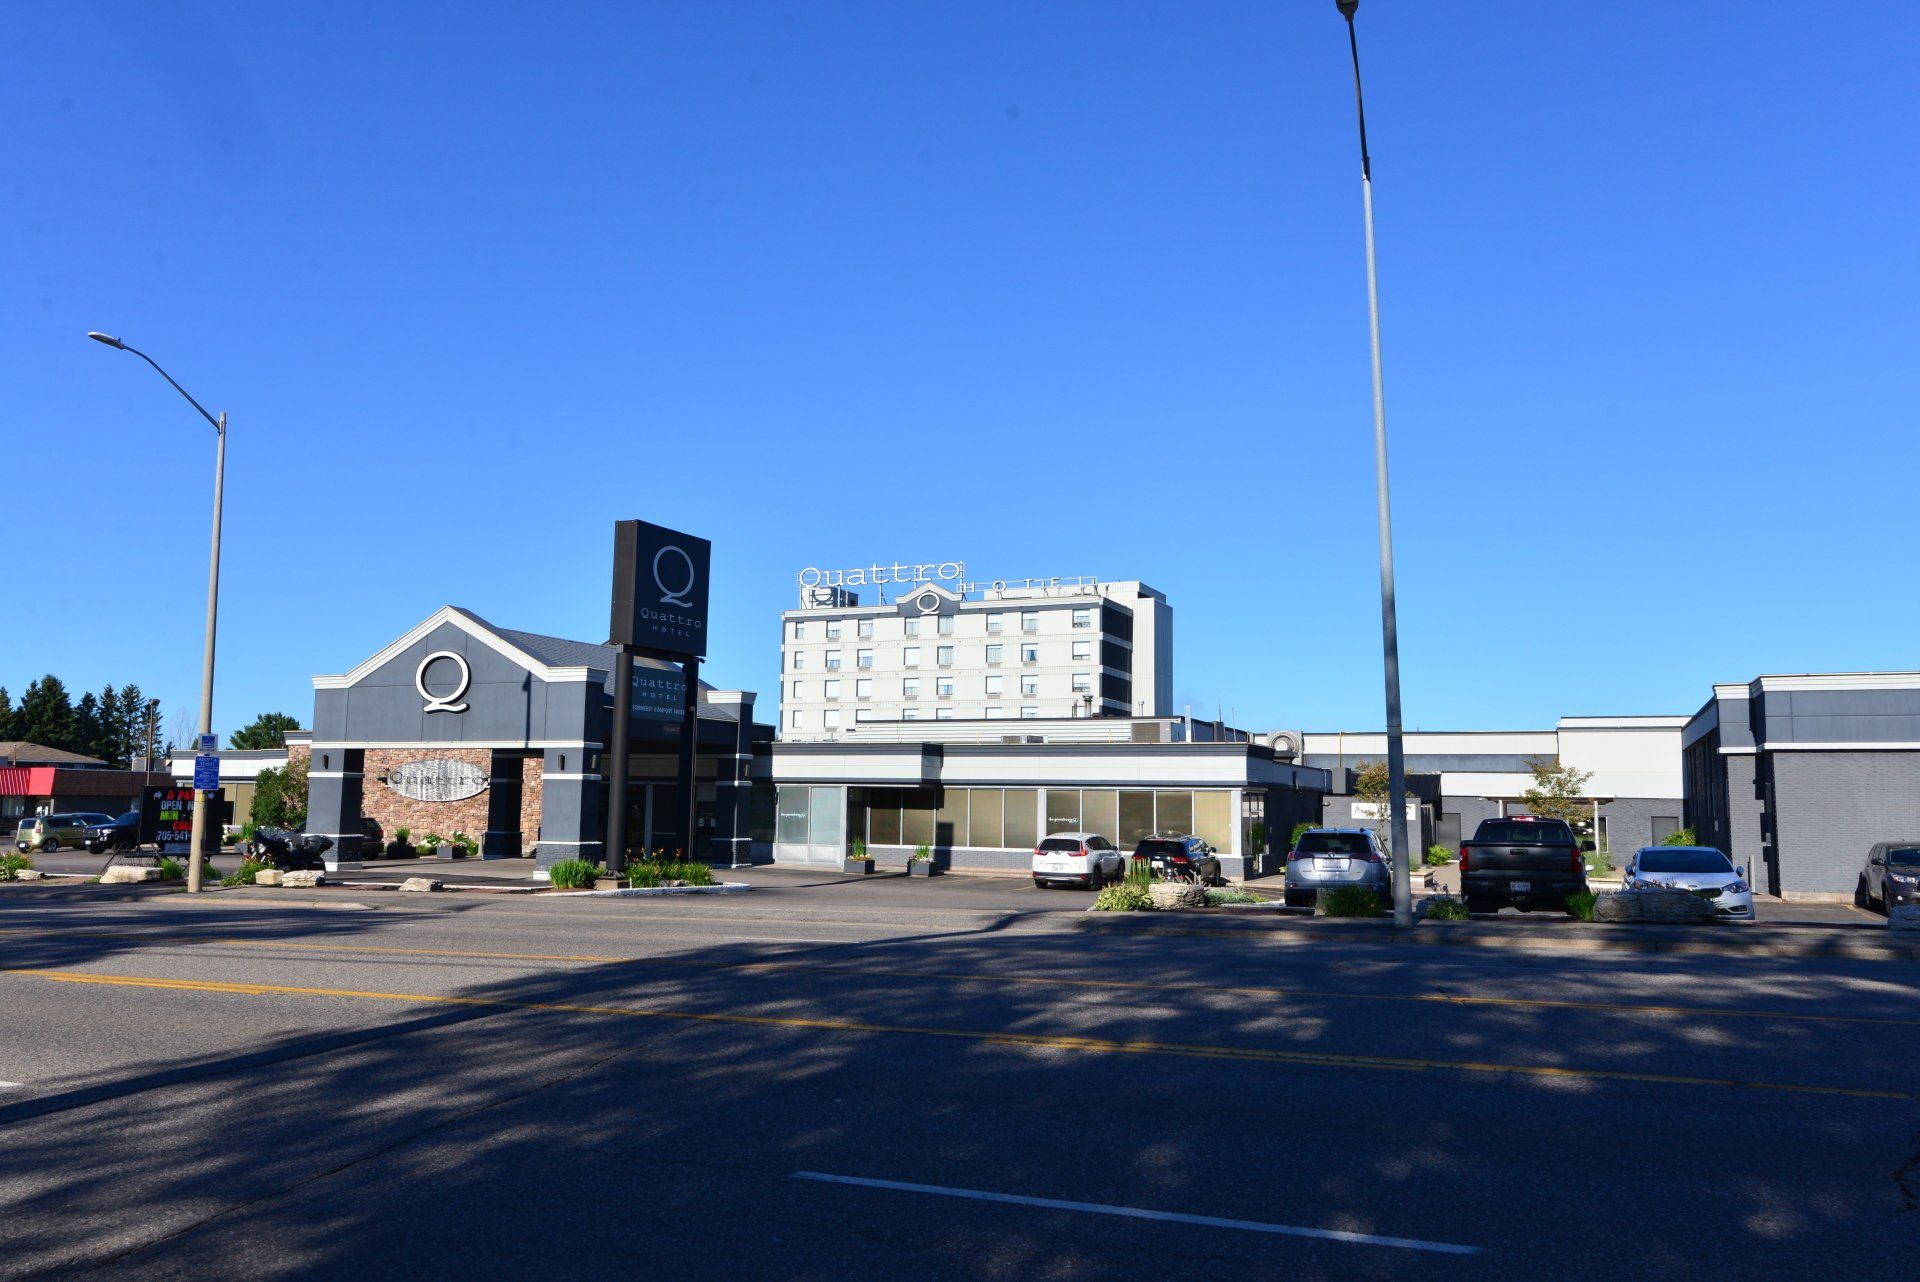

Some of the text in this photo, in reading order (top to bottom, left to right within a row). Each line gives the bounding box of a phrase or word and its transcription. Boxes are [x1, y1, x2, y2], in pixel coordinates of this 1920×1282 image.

[653, 545, 694, 608] Q
[799, 561, 960, 590] Quattro
[963, 575, 1088, 593] HOTEL
[916, 592, 940, 615] Q
[640, 607, 702, 628] Quattro
[652, 625, 690, 637] HOTEL
[416, 651, 469, 711] Q
[632, 675, 688, 692] Quattro
[642, 691, 677, 701] HOTEL
[161, 800, 182, 810] OPEN
[159, 810, 179, 820] MON
